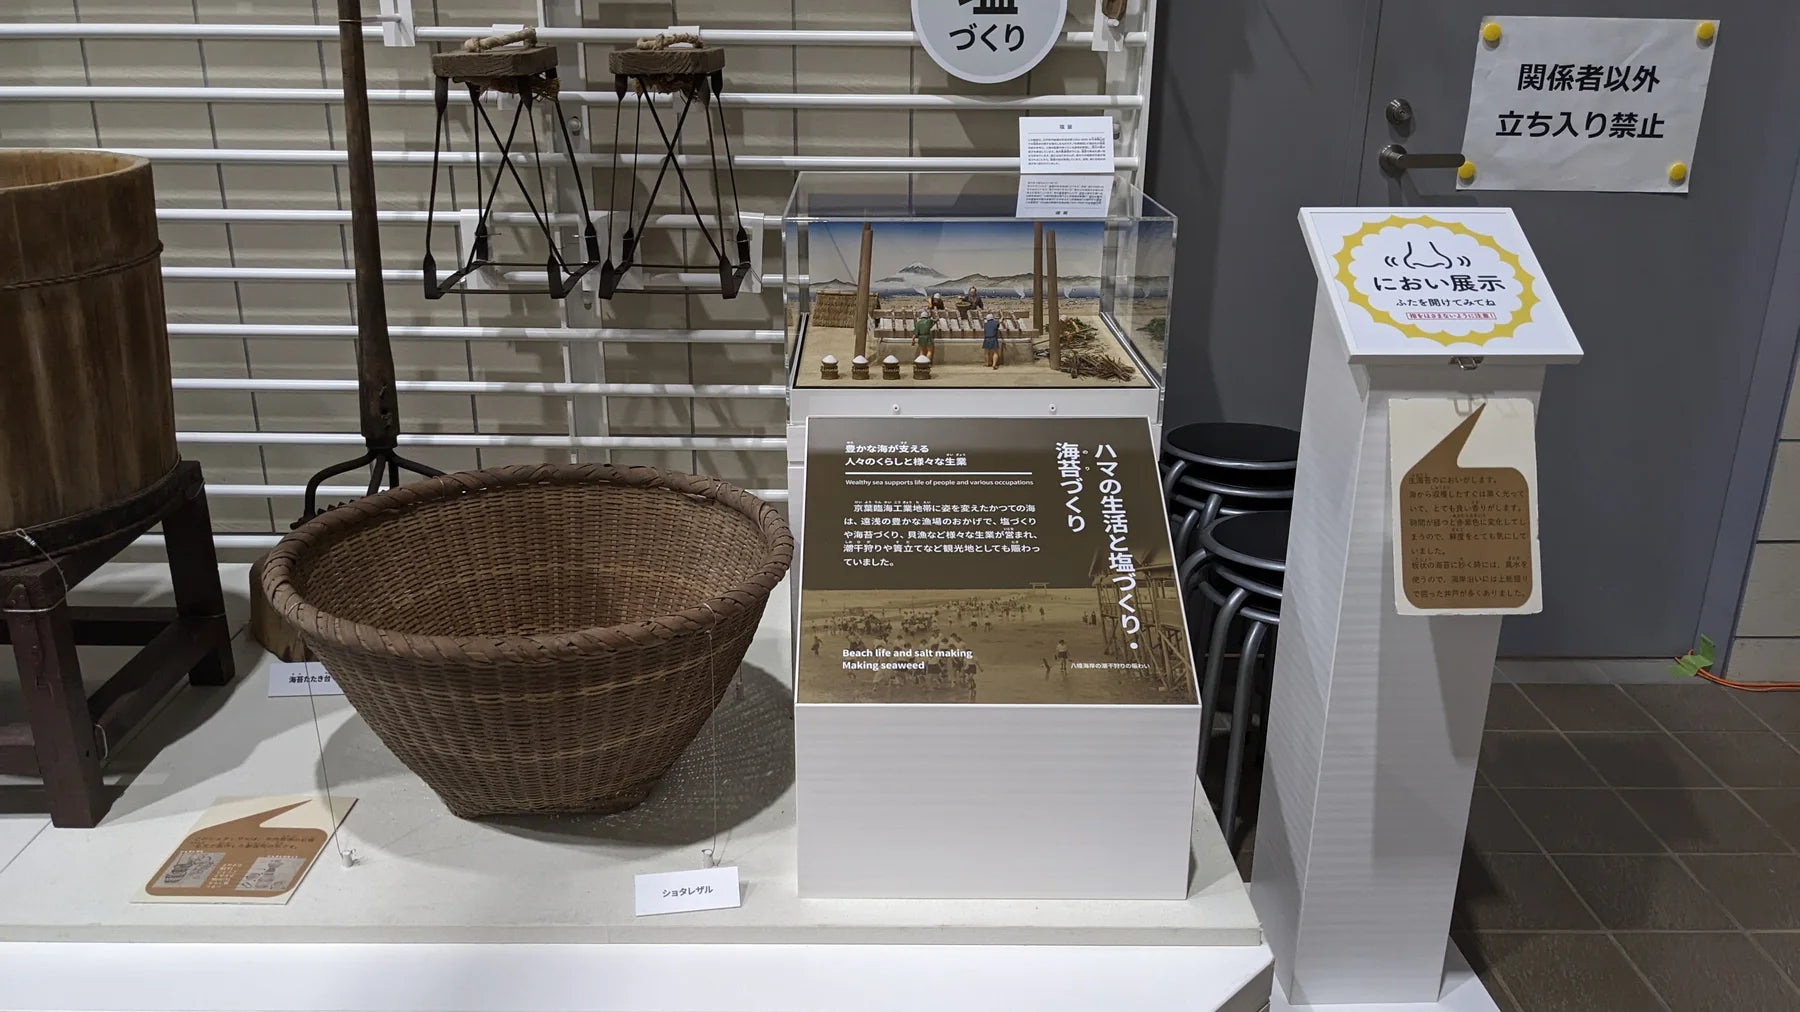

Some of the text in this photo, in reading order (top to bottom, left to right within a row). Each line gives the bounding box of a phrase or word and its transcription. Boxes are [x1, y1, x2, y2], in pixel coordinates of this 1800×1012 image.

[949, 23, 1024, 52] づくり
[1517, 64, 1660, 92] 関係者以外
[1496, 111, 1664, 138] 立ち入り禁止
[1374, 275, 1505, 291] におい展示
[1397, 298, 1496, 306] ふたを開けてみてね
[845, 444, 929, 453] 豊かな海が支える
[845, 457, 967, 466] 人々のくらしと様々な生業
[1056, 442, 1085, 533] 海苔づくり
[854, 504, 1035, 512] 京葉臨海工業地帯に姿を変えたかつての海
[844, 518, 1036, 526] は、遠浅の豊かな漁場のおかげで、塩づくり
[844, 558, 894, 567] ていました。
[843, 649, 972, 659] Beach life and salt making
[843, 661, 925, 670] Making seaweed
[289, 675, 331, 683] 海苔たたき台
[662, 885, 713, 898] ショタレザル
